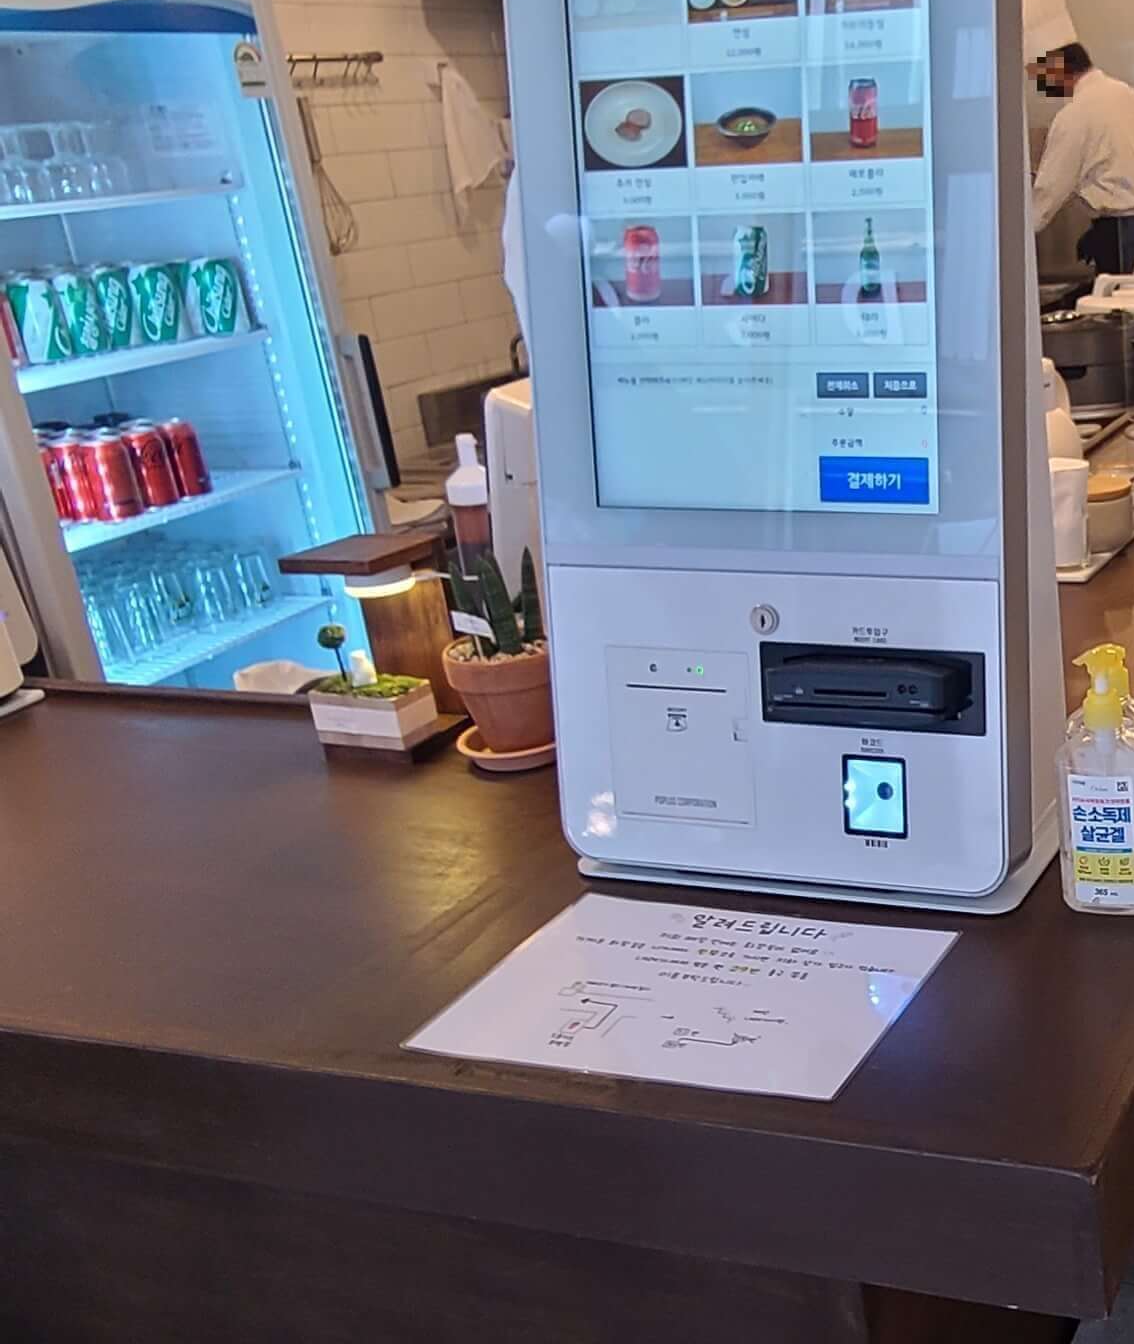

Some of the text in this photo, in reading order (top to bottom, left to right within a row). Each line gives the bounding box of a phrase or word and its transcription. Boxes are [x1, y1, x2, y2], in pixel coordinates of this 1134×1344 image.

[847, 471, 902, 491] 결제하기
[1072, 805, 1132, 824] 손소독제
[1080, 825, 1126, 844] 살균겔
[692, 913, 828, 941] 알려드립니다
